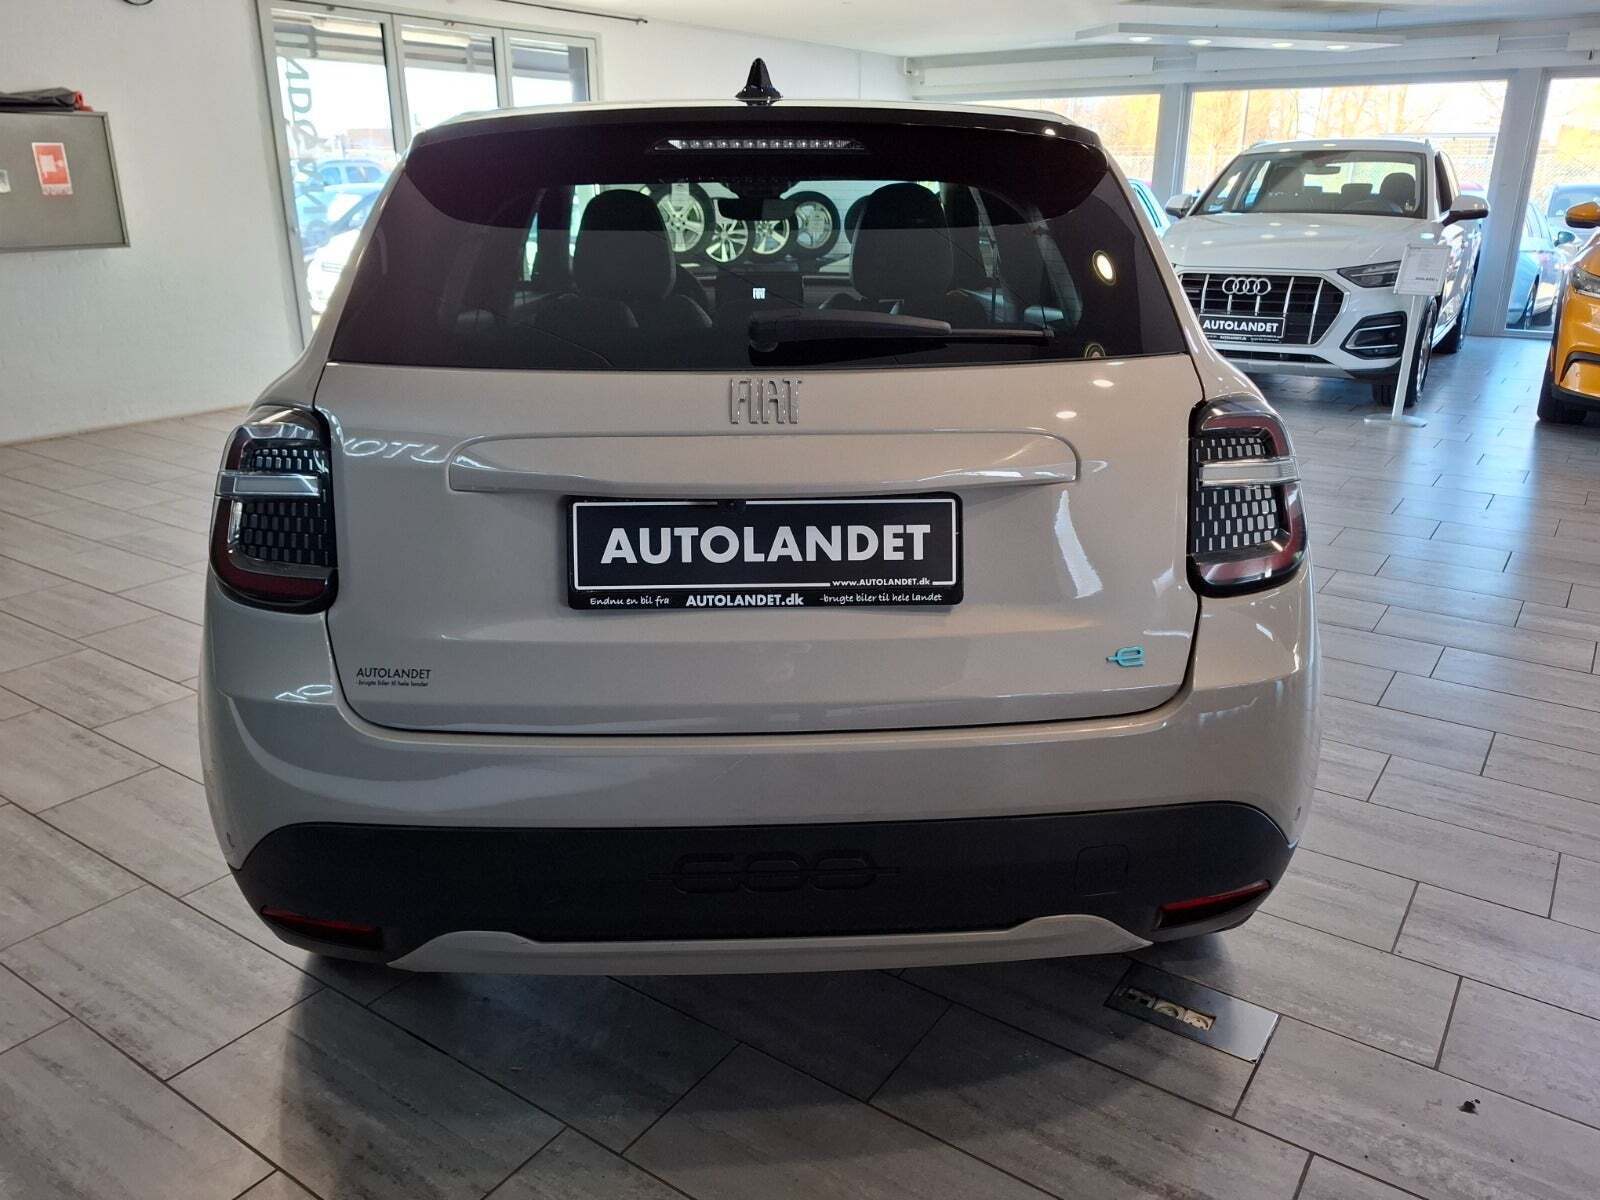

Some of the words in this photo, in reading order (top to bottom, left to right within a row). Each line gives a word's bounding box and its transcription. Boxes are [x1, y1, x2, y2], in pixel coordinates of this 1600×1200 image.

[1202, 319, 1279, 333] AUTOLANDET
[729, 379, 802, 424] FIAT
[600, 524, 931, 564] AUTOLANDET
[831, 577, 931, 587] www.AUTOLANDET.dk
[590, 596, 624, 605] Endnu
[640, 595, 653, 605] bil
[654, 595, 670, 607] fra
[685, 593, 804, 607] AUTOLANDET.dk
[855, 592, 877, 603] biler
[878, 592, 890, 602] til
[892, 593, 910, 602] hele
[911, 592, 942, 602] landet
[356, 668, 432, 679] AUTOLANDET
